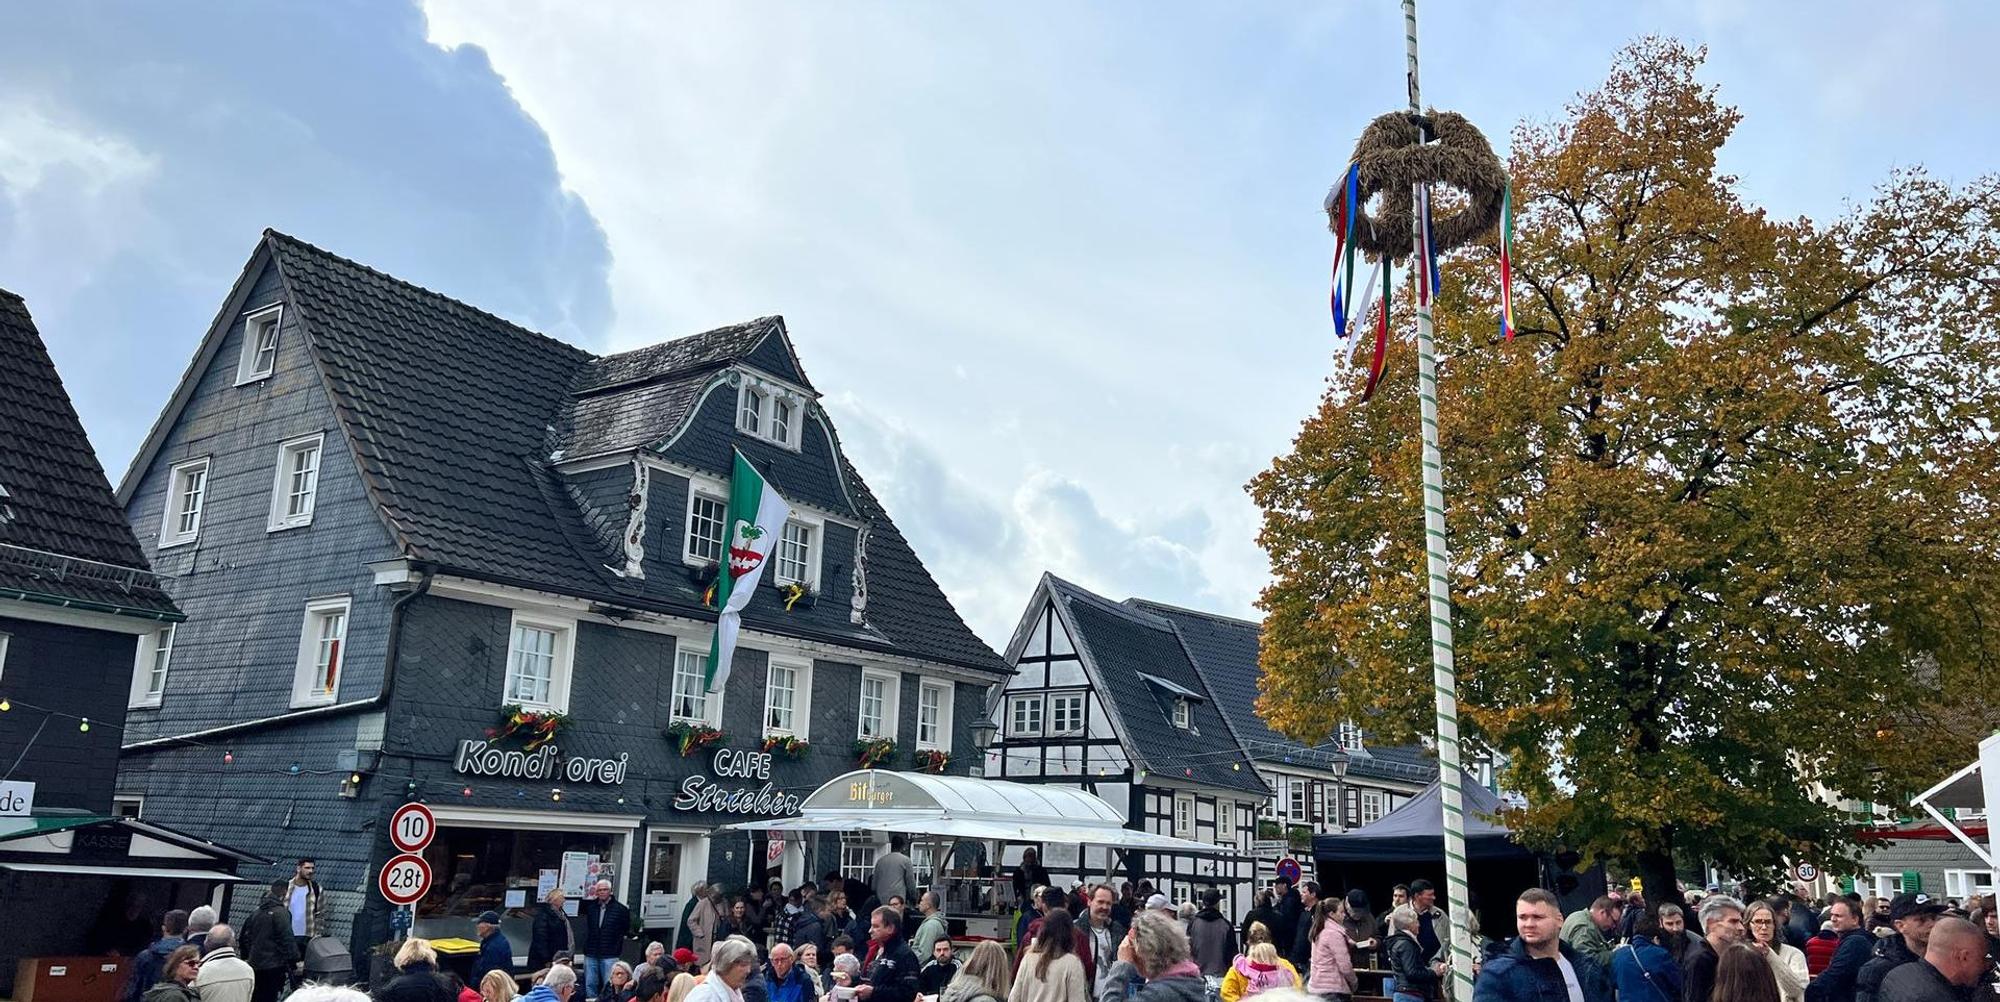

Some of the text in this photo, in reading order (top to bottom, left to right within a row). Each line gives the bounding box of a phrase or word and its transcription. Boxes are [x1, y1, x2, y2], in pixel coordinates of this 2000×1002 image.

[713, 748, 772, 779] CAFE
[402, 816, 425, 838] 10
[79, 834, 128, 849] KASSE
[1799, 866, 1814, 877] 30
